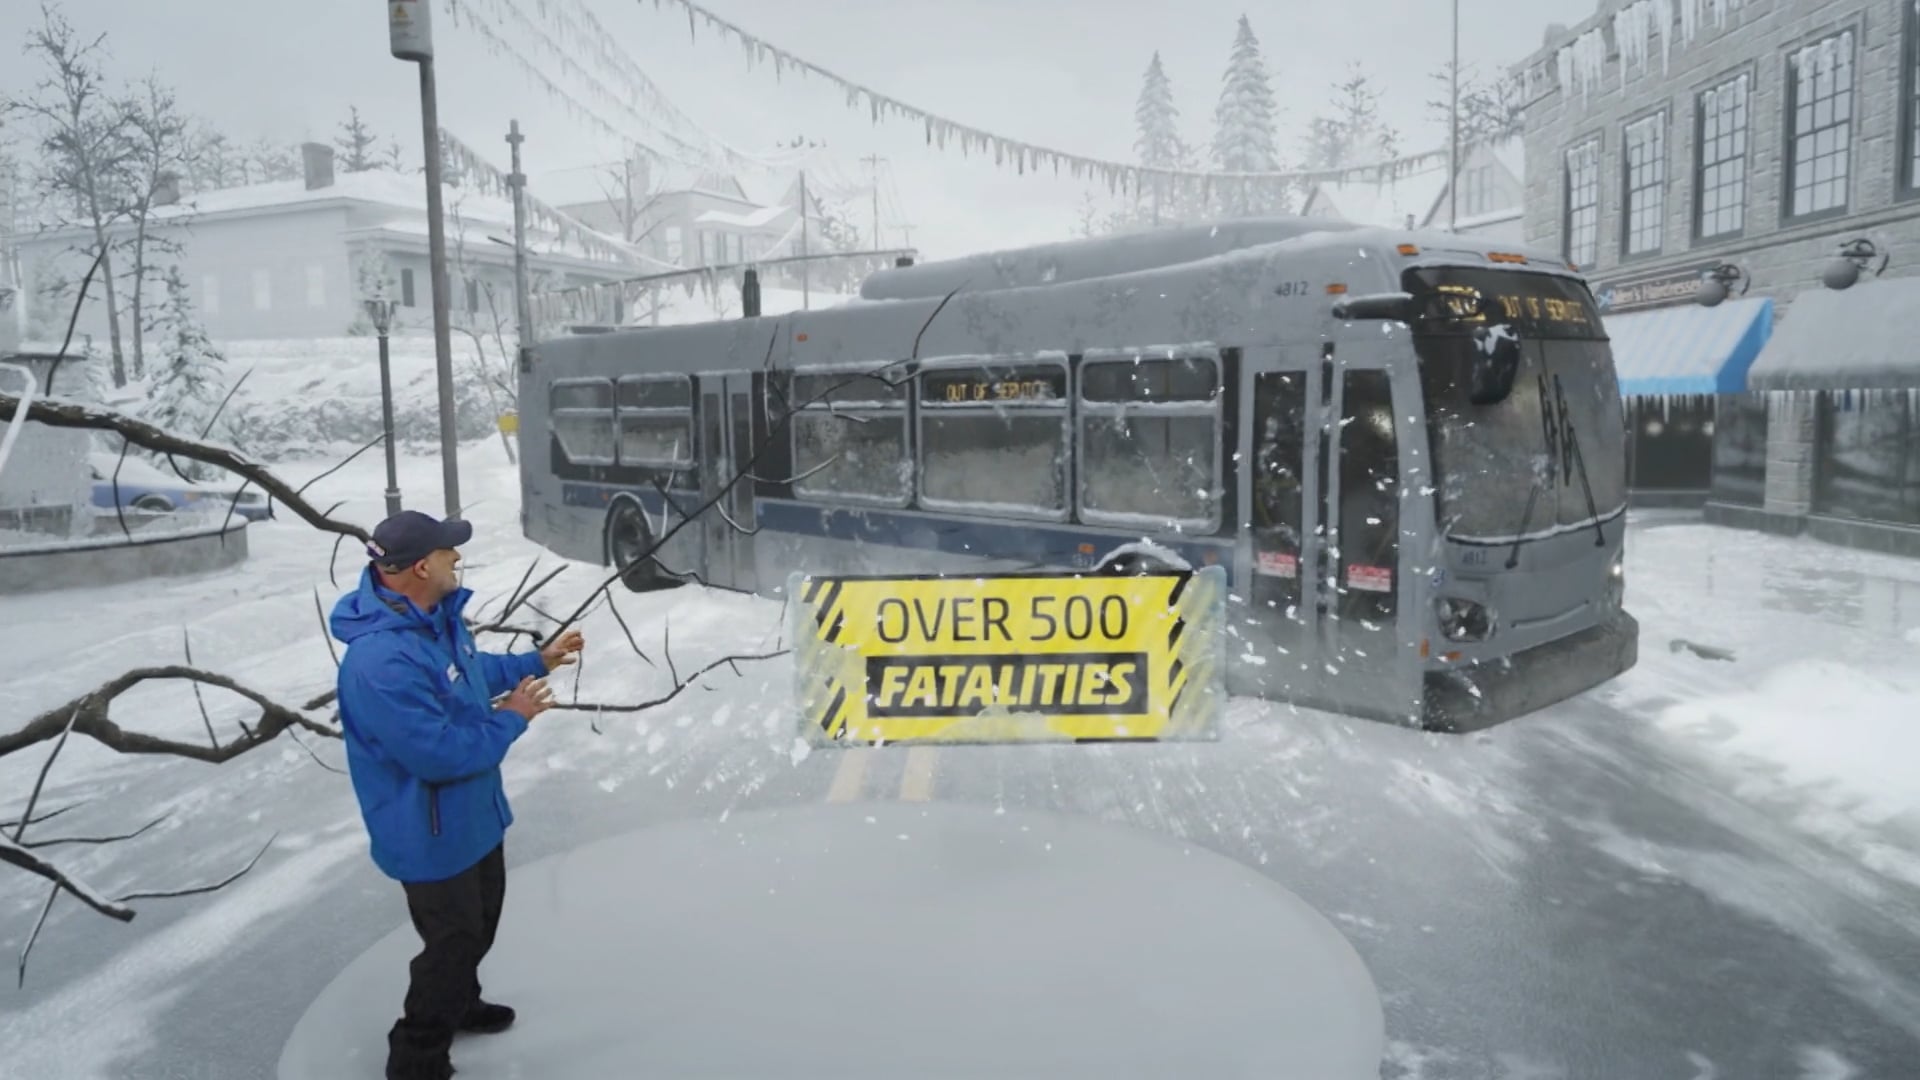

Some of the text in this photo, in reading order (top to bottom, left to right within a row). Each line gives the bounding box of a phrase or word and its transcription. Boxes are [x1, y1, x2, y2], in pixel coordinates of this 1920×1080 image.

[1274, 281, 1310, 297] 4812
[1499, 295, 1521, 319] OUT
[946, 383, 967, 401] OUT
[973, 383, 988, 400] OF
[877, 594, 1129, 644] OVER 500
[877, 663, 1137, 708] FATALITIES
